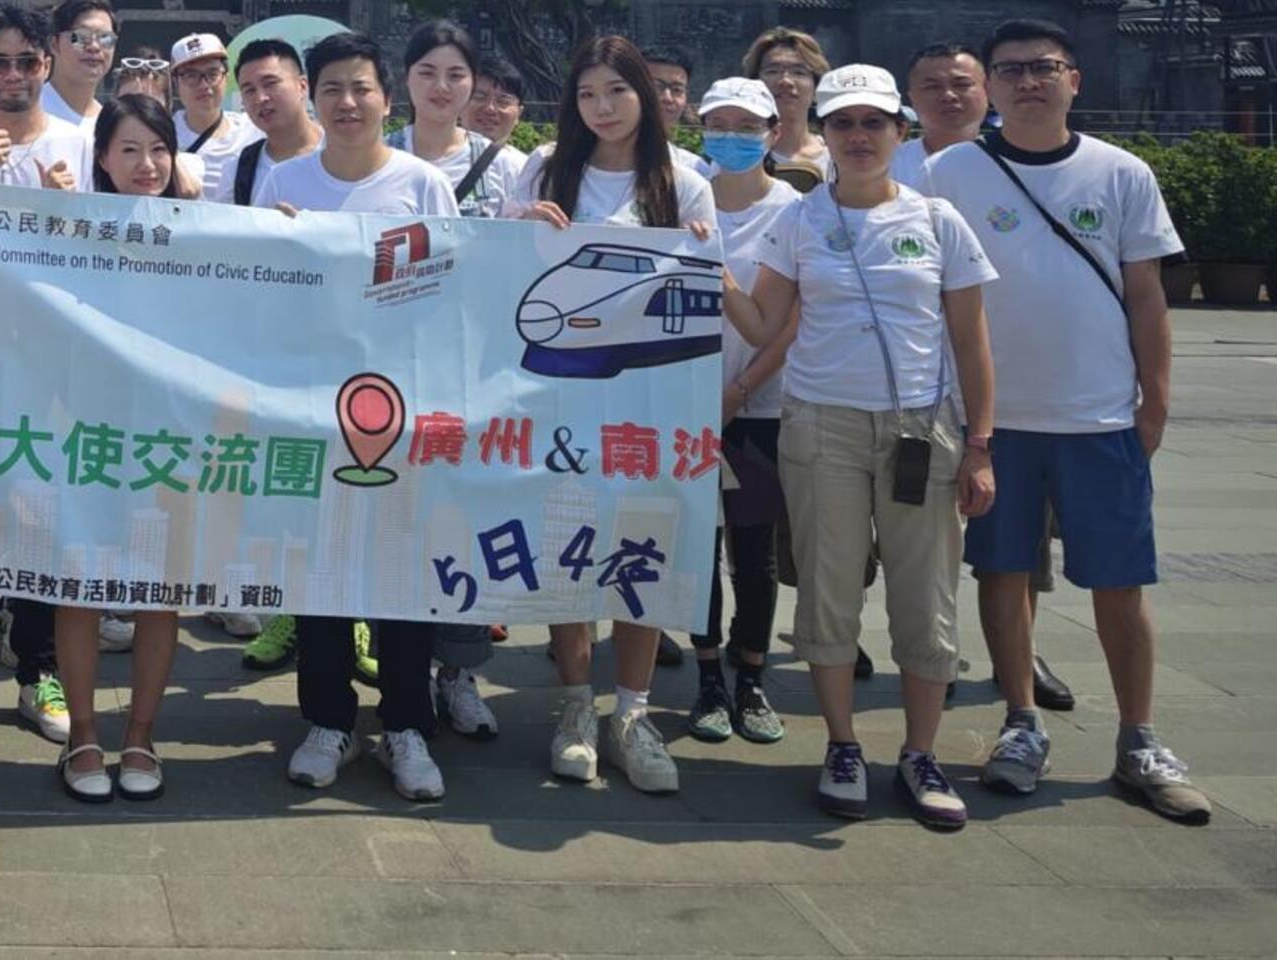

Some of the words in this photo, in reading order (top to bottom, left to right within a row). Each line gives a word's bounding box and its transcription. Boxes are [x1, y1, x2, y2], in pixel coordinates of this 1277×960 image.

[70, 256, 88, 269] on
[92, 255, 114, 271] the
[119, 257, 192, 277] Promotion
[197, 263, 211, 278] of
[215, 264, 249, 281] Civic
[253, 266, 323, 286] Education
[408, 411, 533, 470] 廣州
[545, 426, 589, 475] &
[600, 422, 723, 481] 南沙
